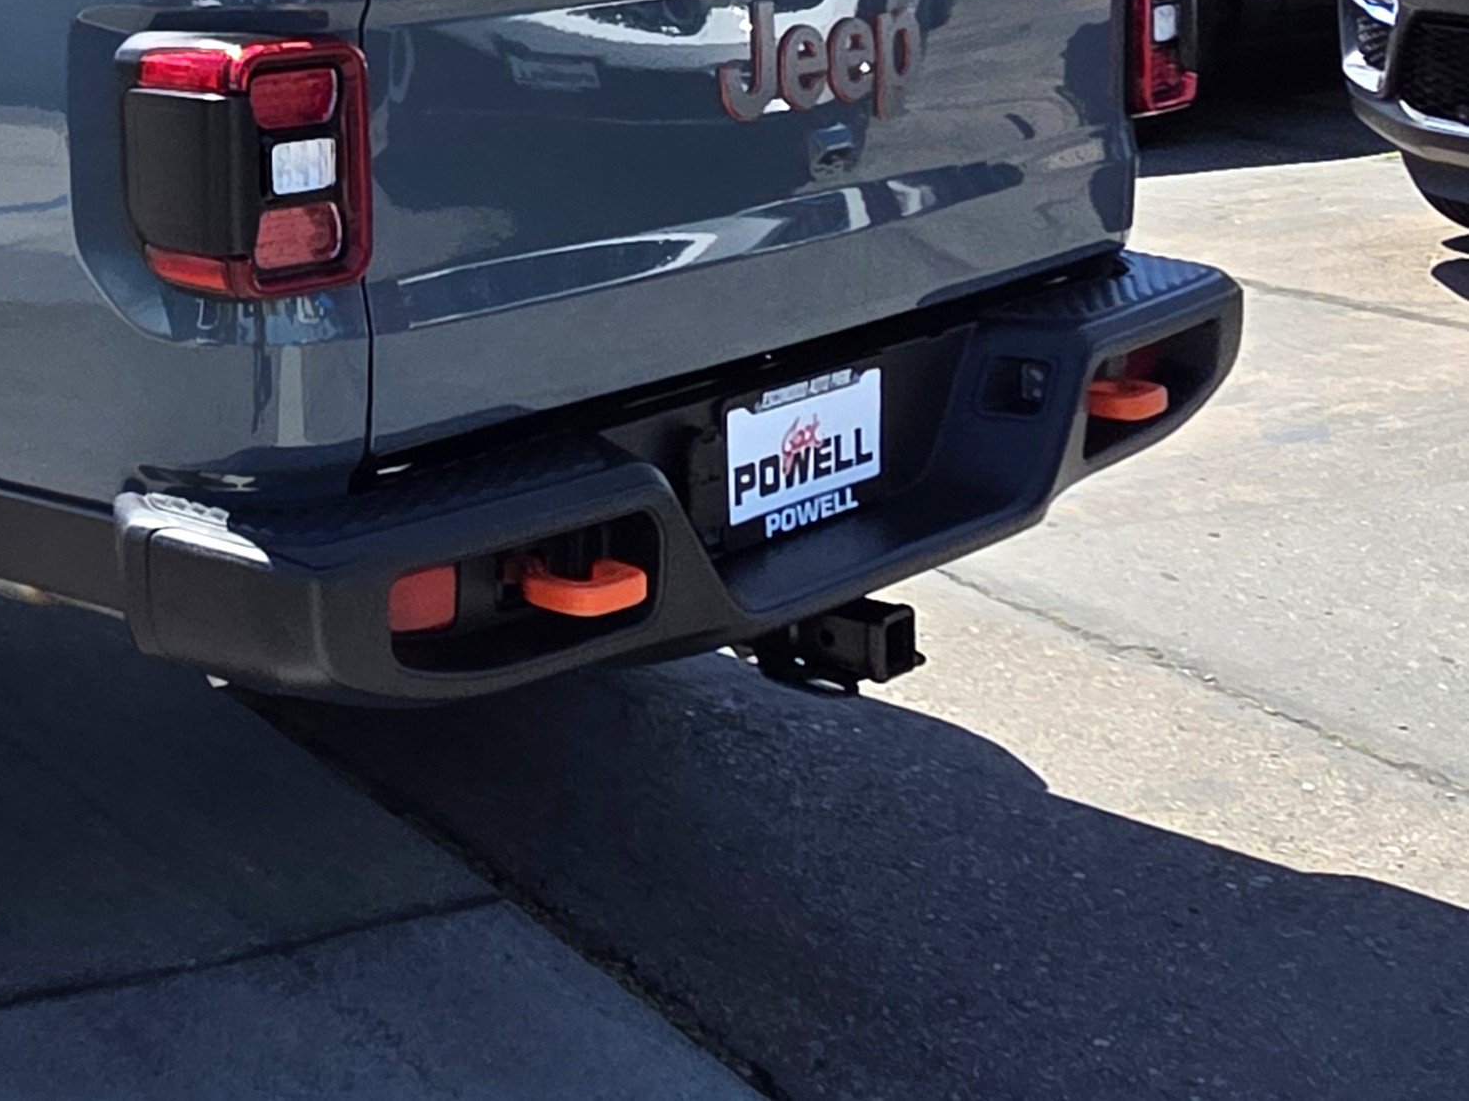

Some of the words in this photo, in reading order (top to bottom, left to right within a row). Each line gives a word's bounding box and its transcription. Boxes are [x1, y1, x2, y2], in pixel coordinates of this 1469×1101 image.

[719, 1, 920, 121] Jeep
[734, 428, 873, 506] POWELL
[765, 488, 859, 538] POWELL
